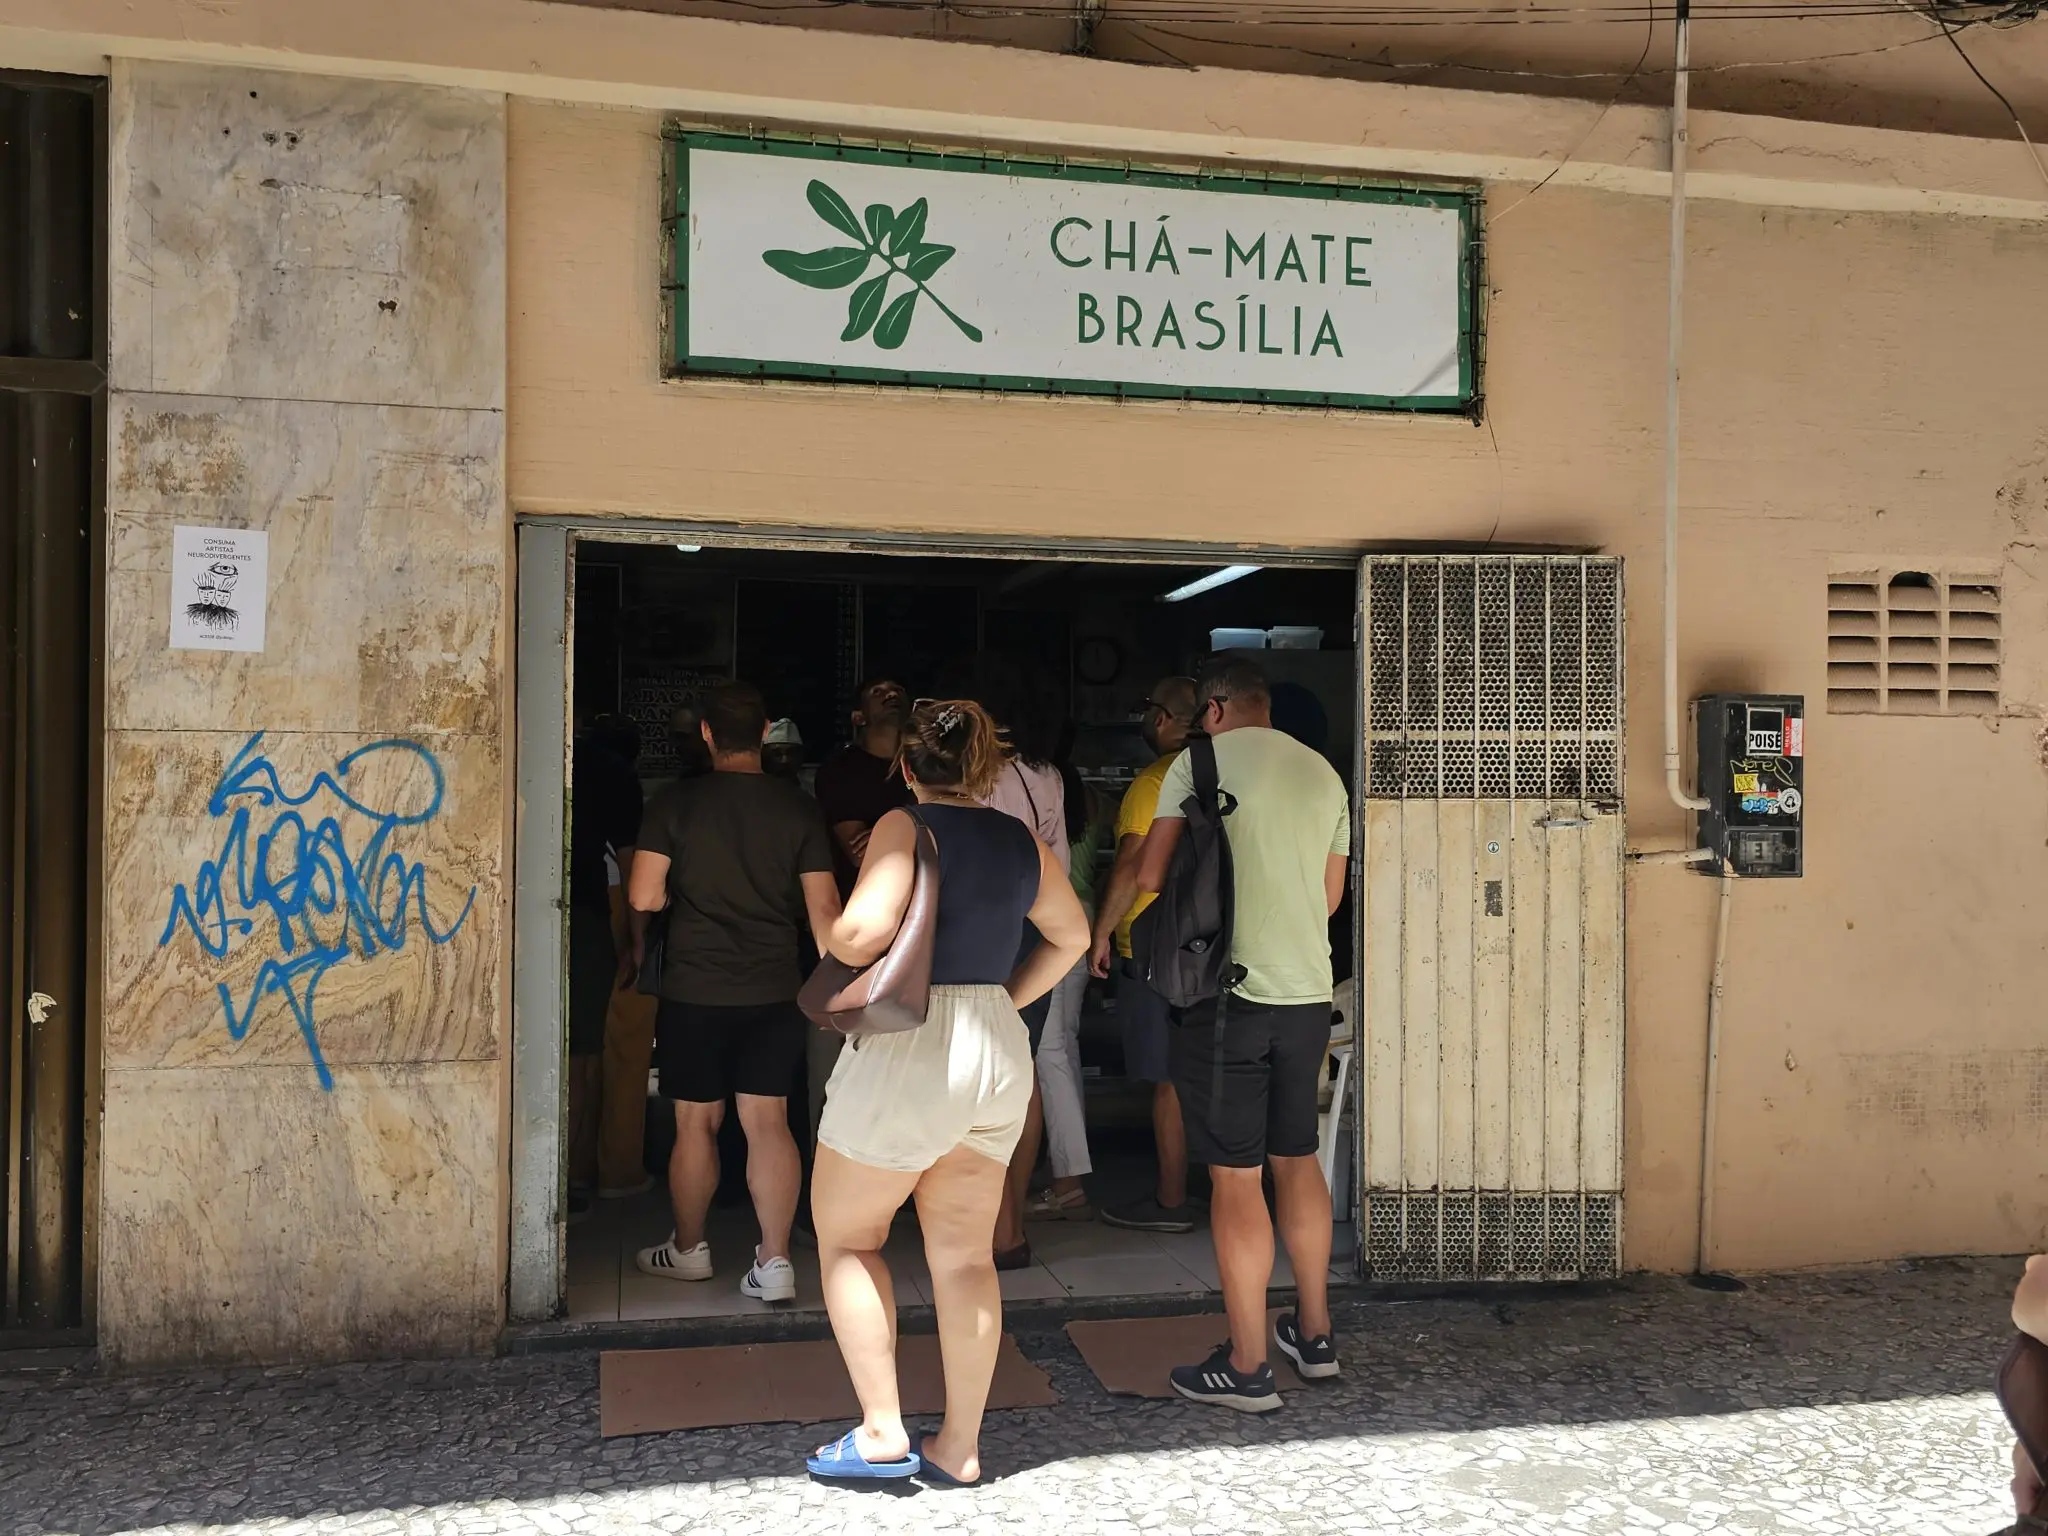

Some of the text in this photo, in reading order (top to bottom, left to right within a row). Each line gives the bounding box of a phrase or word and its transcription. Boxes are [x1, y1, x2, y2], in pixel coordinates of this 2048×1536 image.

[1050, 215, 1372, 287] CHÁ-MATE
[1078, 293, 1343, 358] BRASÍLIA
[187, 552, 251, 561] NEURODIVERGENTES
[204, 538, 235, 546] CONSUMA
